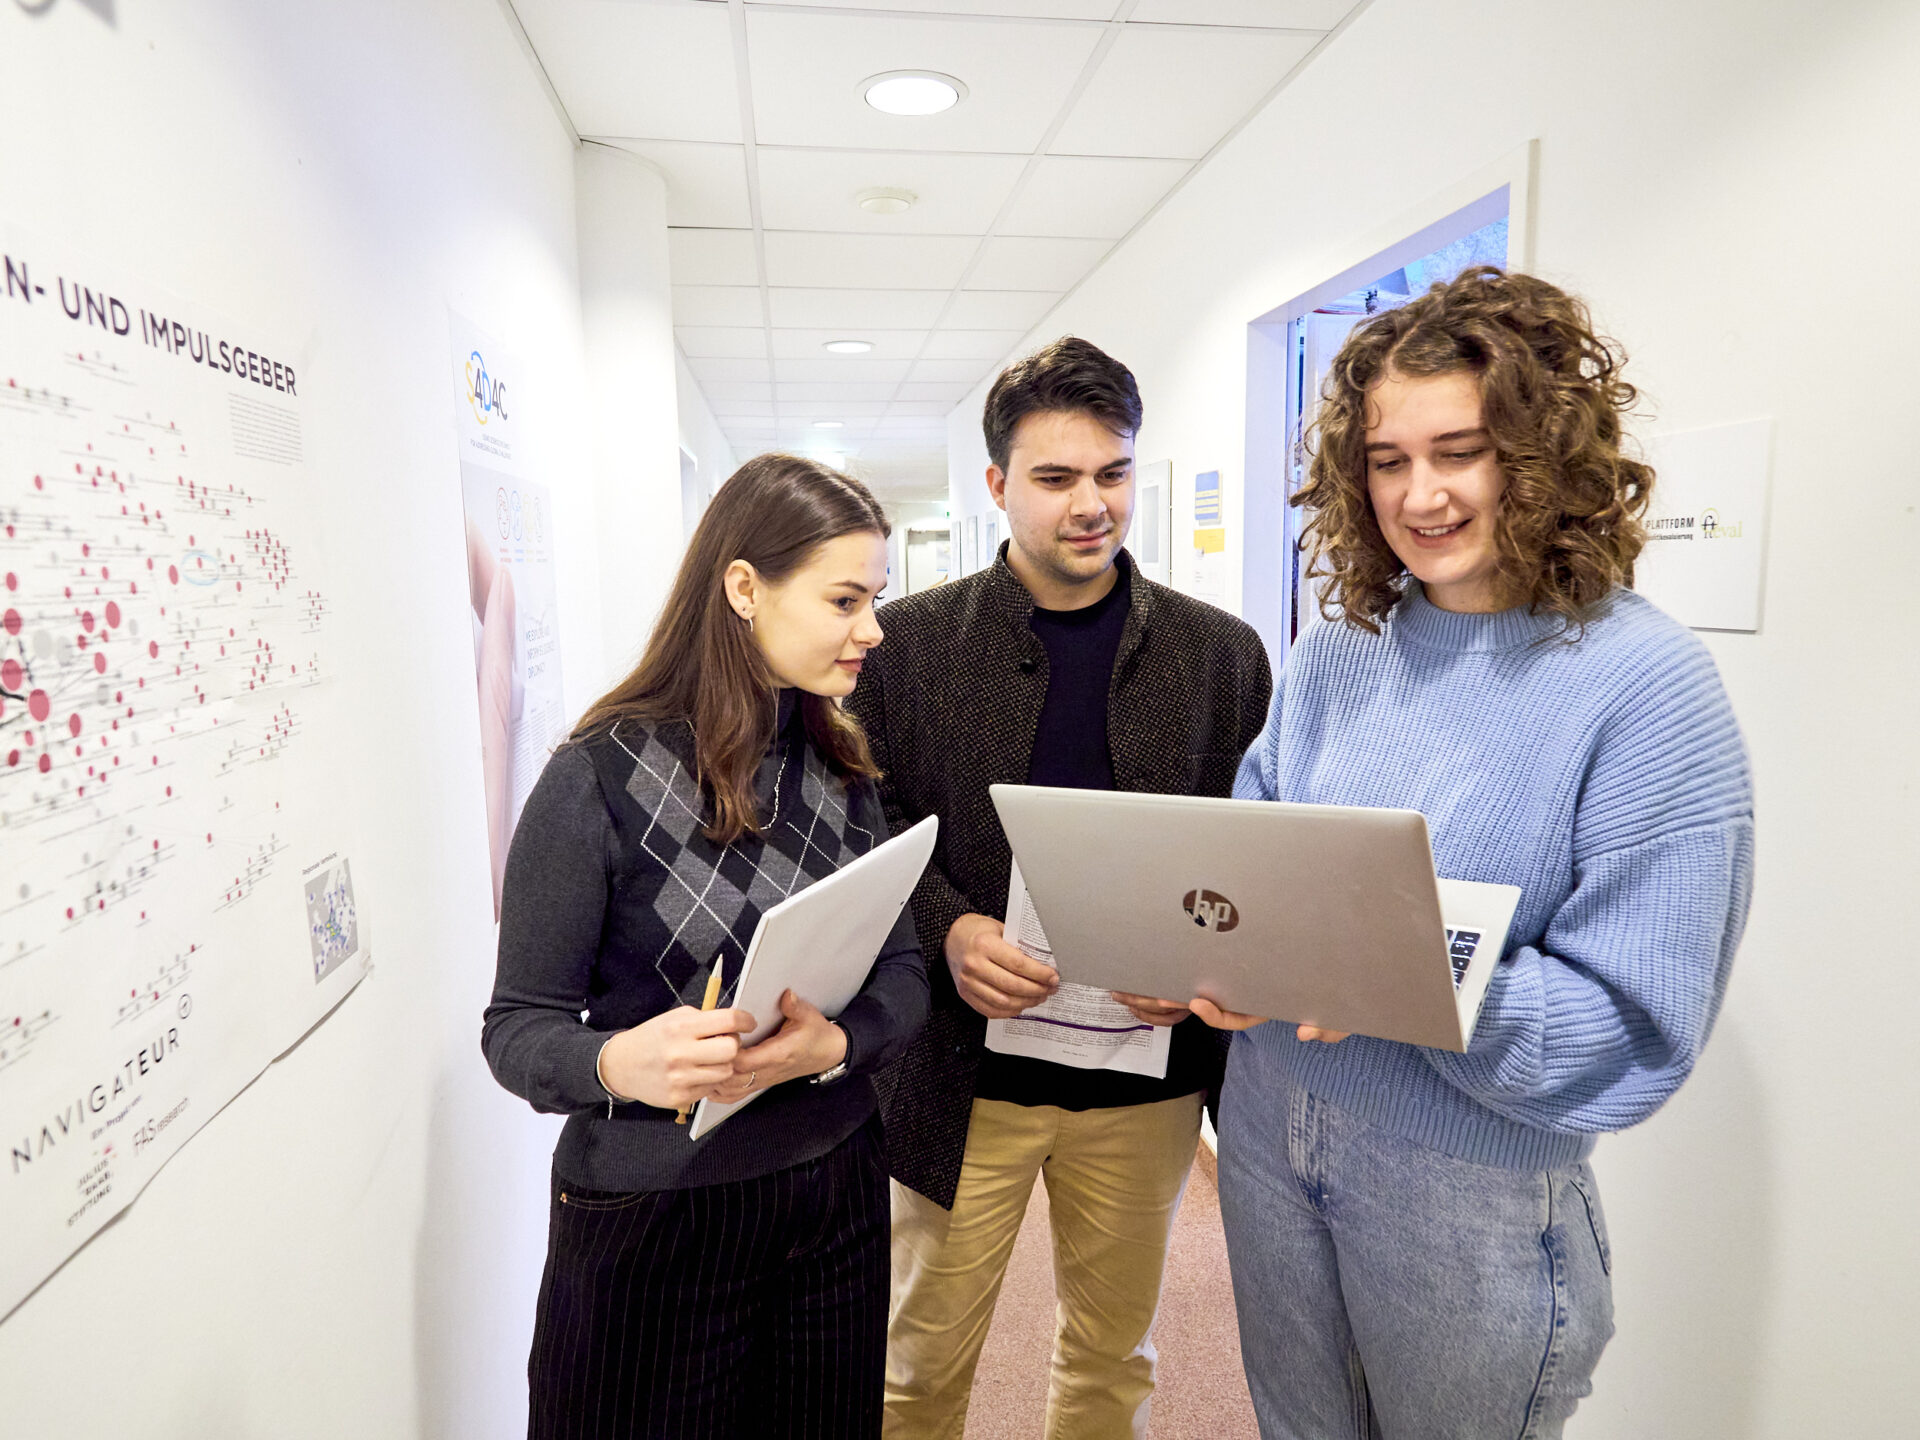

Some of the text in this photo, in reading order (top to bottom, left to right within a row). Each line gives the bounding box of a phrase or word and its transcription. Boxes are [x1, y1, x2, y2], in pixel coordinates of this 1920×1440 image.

[0, 254, 298, 397] N- UND IMPULSGEBER
[1645, 517, 1695, 530] PLATTFORM
[1193, 889, 1231, 932] hp
[9, 1027, 181, 1174] NAVIGATEUR
